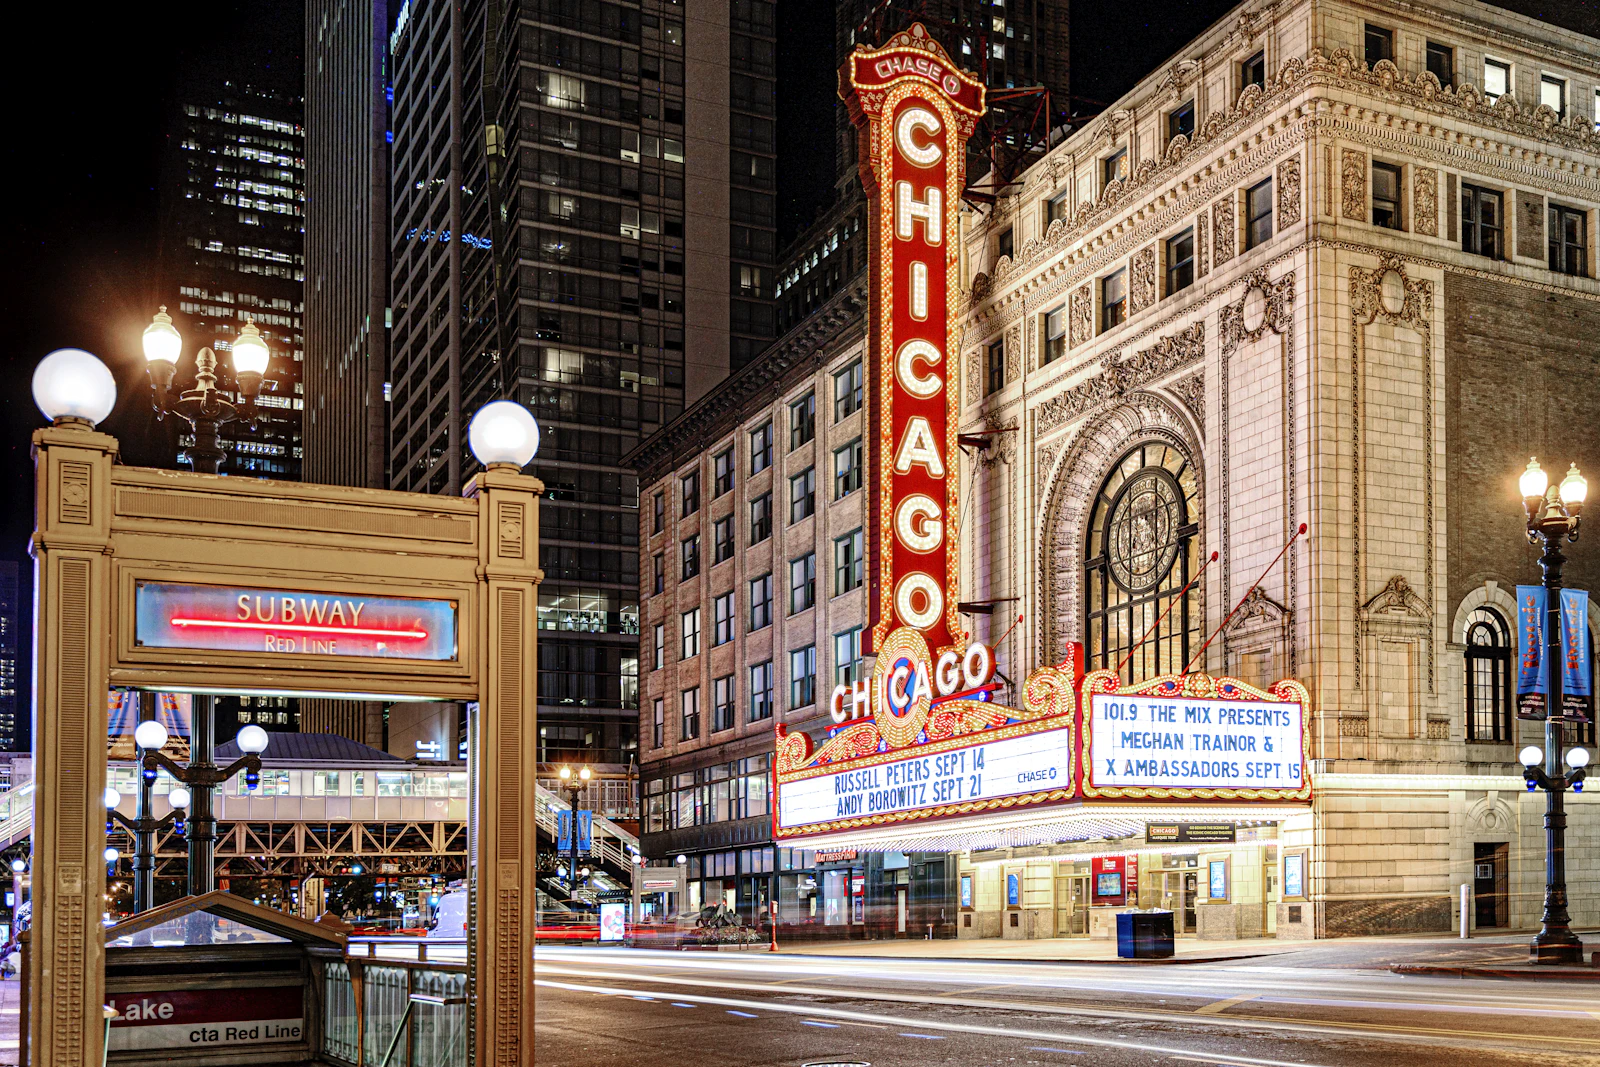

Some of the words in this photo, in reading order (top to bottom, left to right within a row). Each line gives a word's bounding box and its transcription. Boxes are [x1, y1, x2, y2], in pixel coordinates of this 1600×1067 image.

[875, 56, 943, 83] CHASE
[894, 106, 945, 631] CHICAGO
[236, 594, 365, 627] SUBWAY
[264, 634, 296, 653] RED
[302, 636, 337, 655] LINE
[831, 642, 990, 723] CHICAGO
[1104, 702, 1138, 721] 101.9
[1148, 705, 1176, 723] THE
[1185, 706, 1212, 724] MIX
[1218, 708, 1290, 727] PRESENTS
[1121, 731, 1184, 750] MEGHAN
[1192, 734, 1257, 752] TRAINOR
[1263, 736, 1273, 752] &
[834, 769, 881, 795] RUSSELL
[886, 758, 930, 786] PETERS
[935, 751, 966, 778] SEPT
[972, 747, 985, 772] 14
[1017, 769, 1047, 784] CHASE
[1105, 758, 1116, 776] X
[1124, 759, 1240, 778] AMBASSADORS
[1246, 762, 1281, 779] SEPT
[1288, 763, 1300, 779] 15
[836, 792, 868, 817] ANDY
[868, 783, 927, 812] BOROWITZ
[933, 777, 964, 802] SEPT
[969, 773, 982, 797] 21
[109, 999, 174, 1021] Lake
[189, 1027, 219, 1043] cta
[225, 1026, 259, 1041] Red
[265, 1024, 301, 1039] Line
